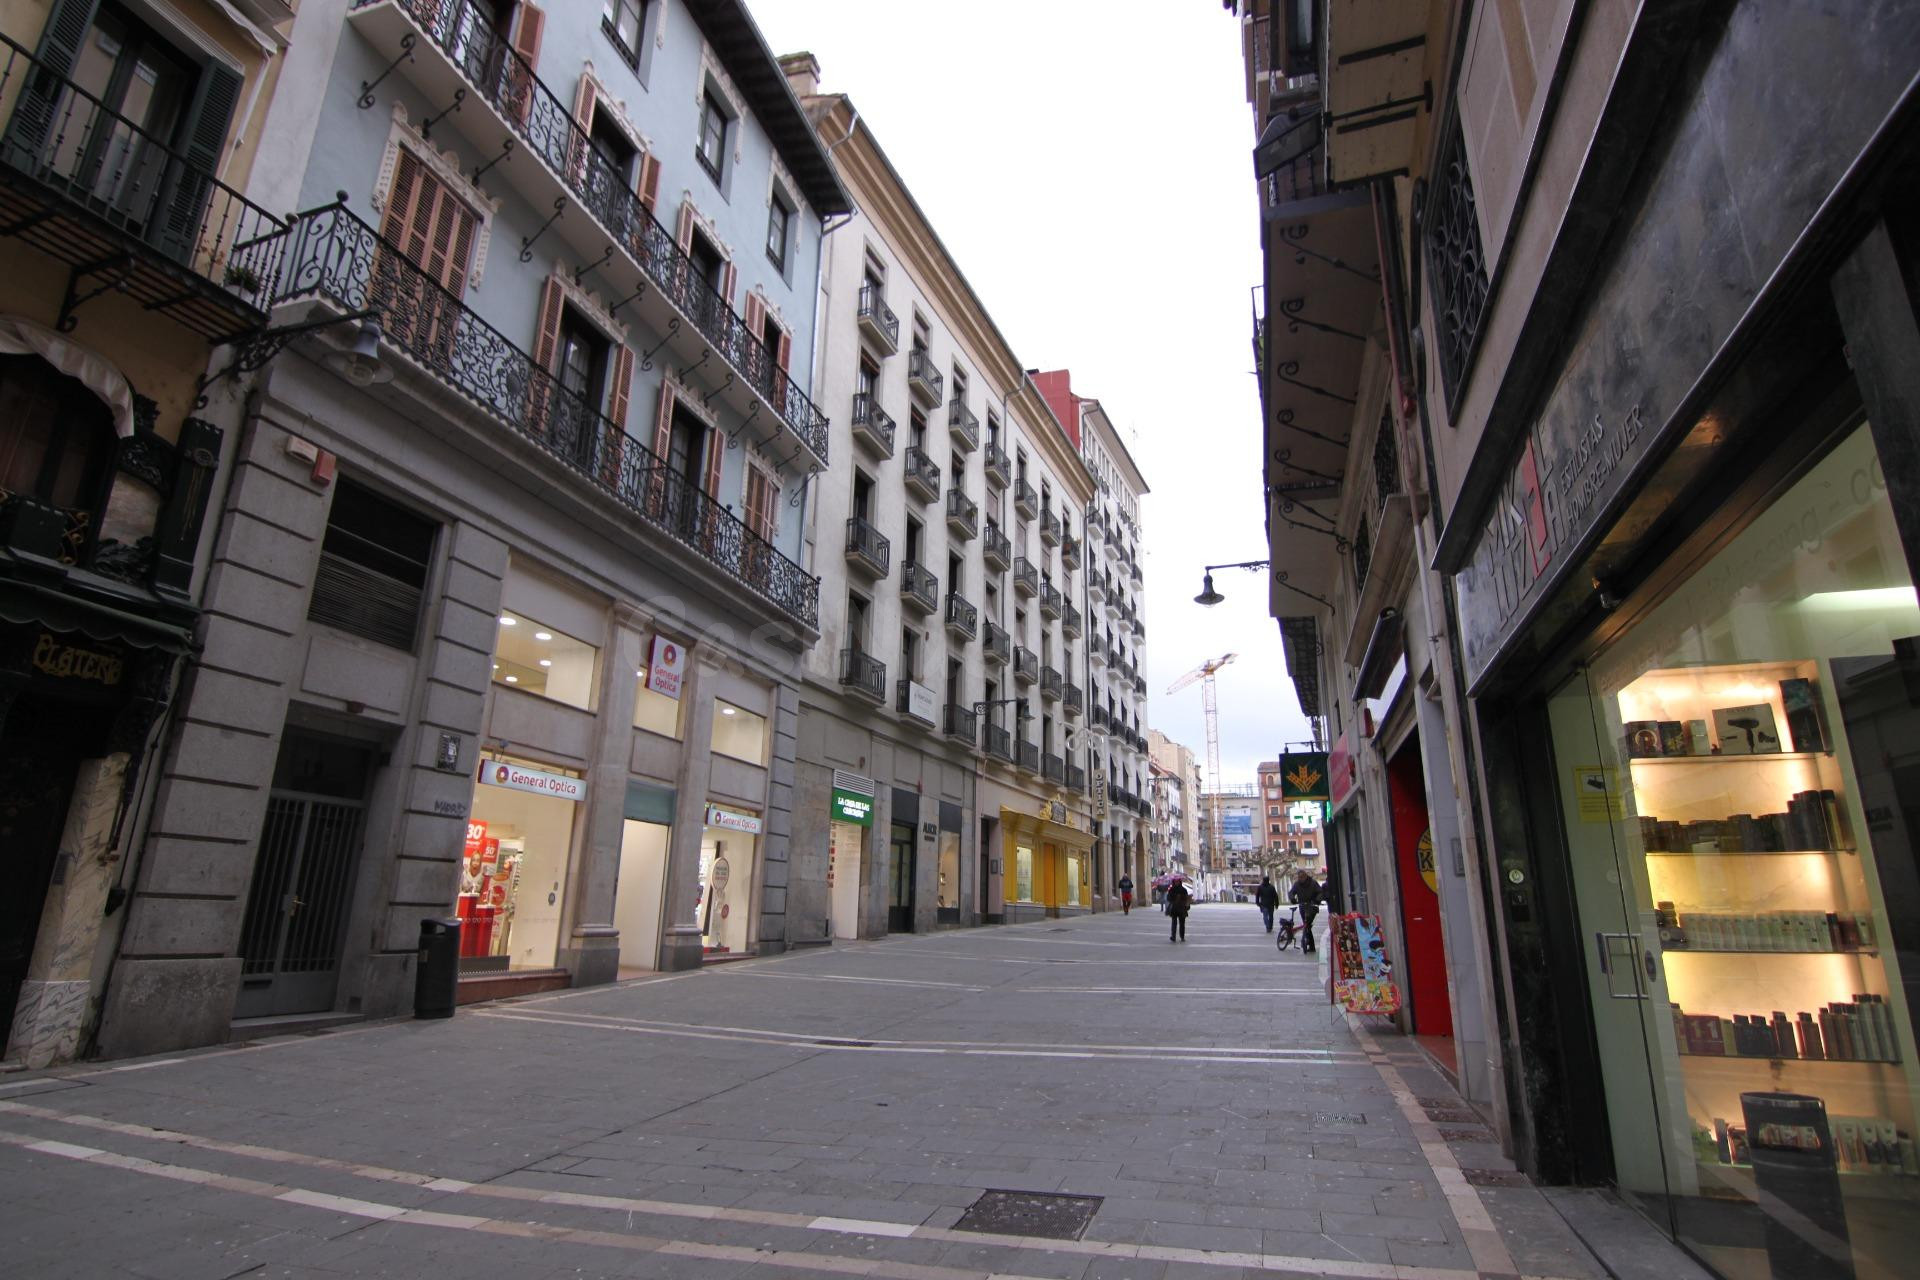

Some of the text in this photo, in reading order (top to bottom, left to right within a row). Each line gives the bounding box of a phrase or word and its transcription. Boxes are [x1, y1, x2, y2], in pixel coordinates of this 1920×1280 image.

[1560, 413, 1603, 495] ESTILISTAS
[1566, 403, 1645, 529] HOMBRE-MUJER
[655, 665, 680, 683] General
[655, 676, 677, 692] Optica
[511, 771, 577, 794] General Optica
[722, 815, 757, 829] General Optica
